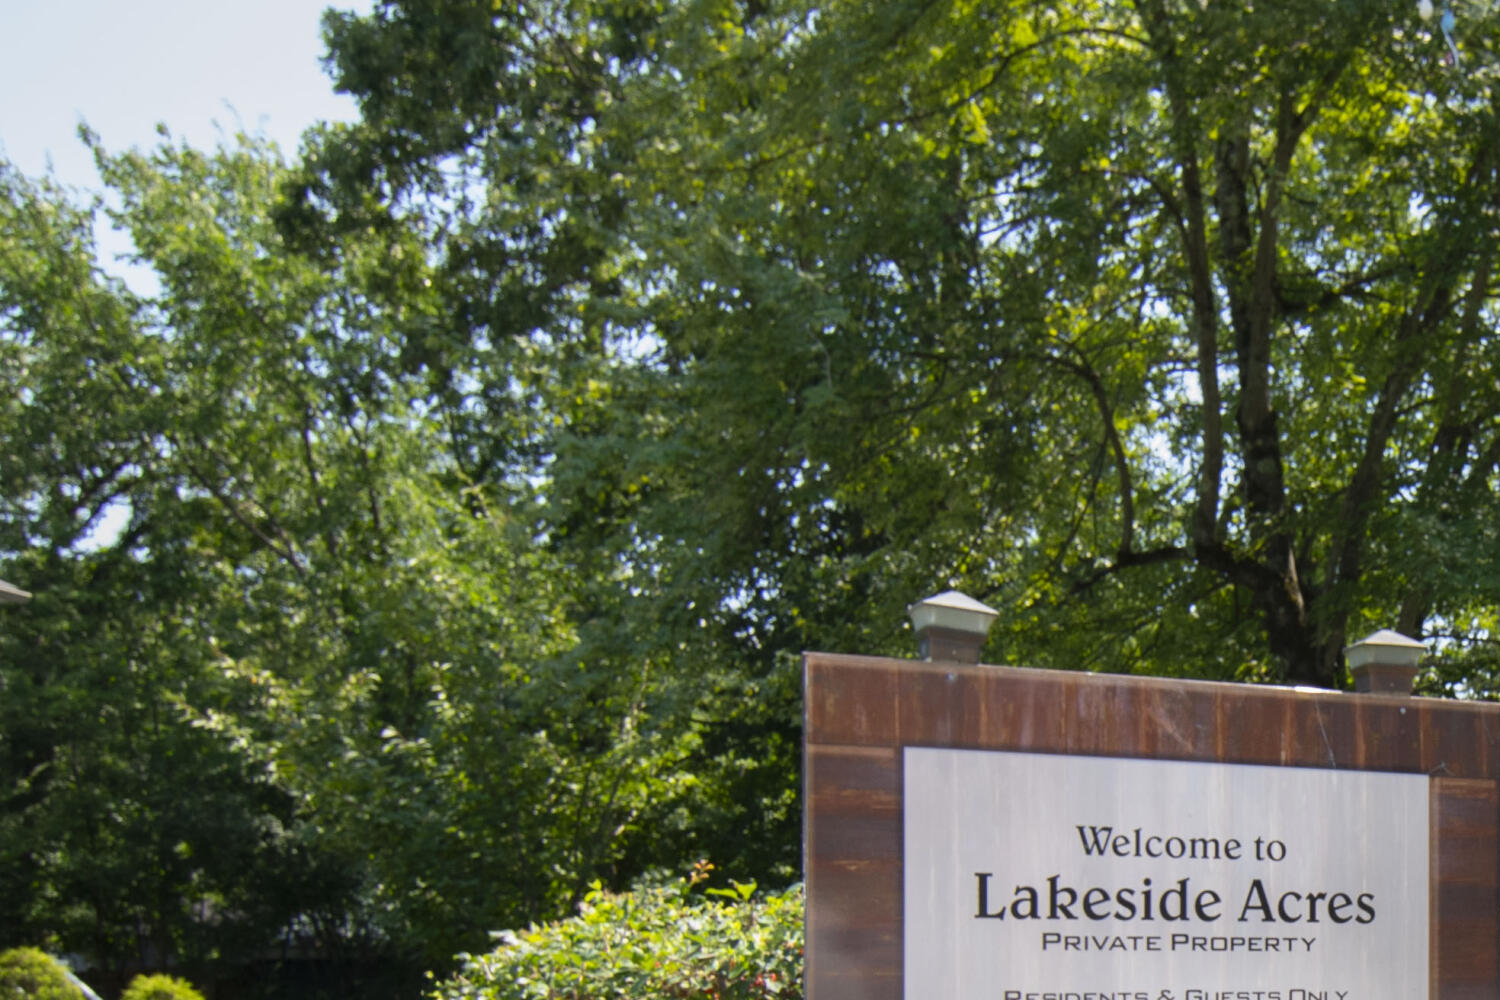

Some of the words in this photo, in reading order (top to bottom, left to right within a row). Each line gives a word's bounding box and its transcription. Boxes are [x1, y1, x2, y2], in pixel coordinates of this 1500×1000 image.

[1075, 825, 1242, 861] Welcome
[1254, 837, 1287, 862] to
[973, 872, 1222, 923] Lakeside
[1237, 878, 1377, 926] Acres
